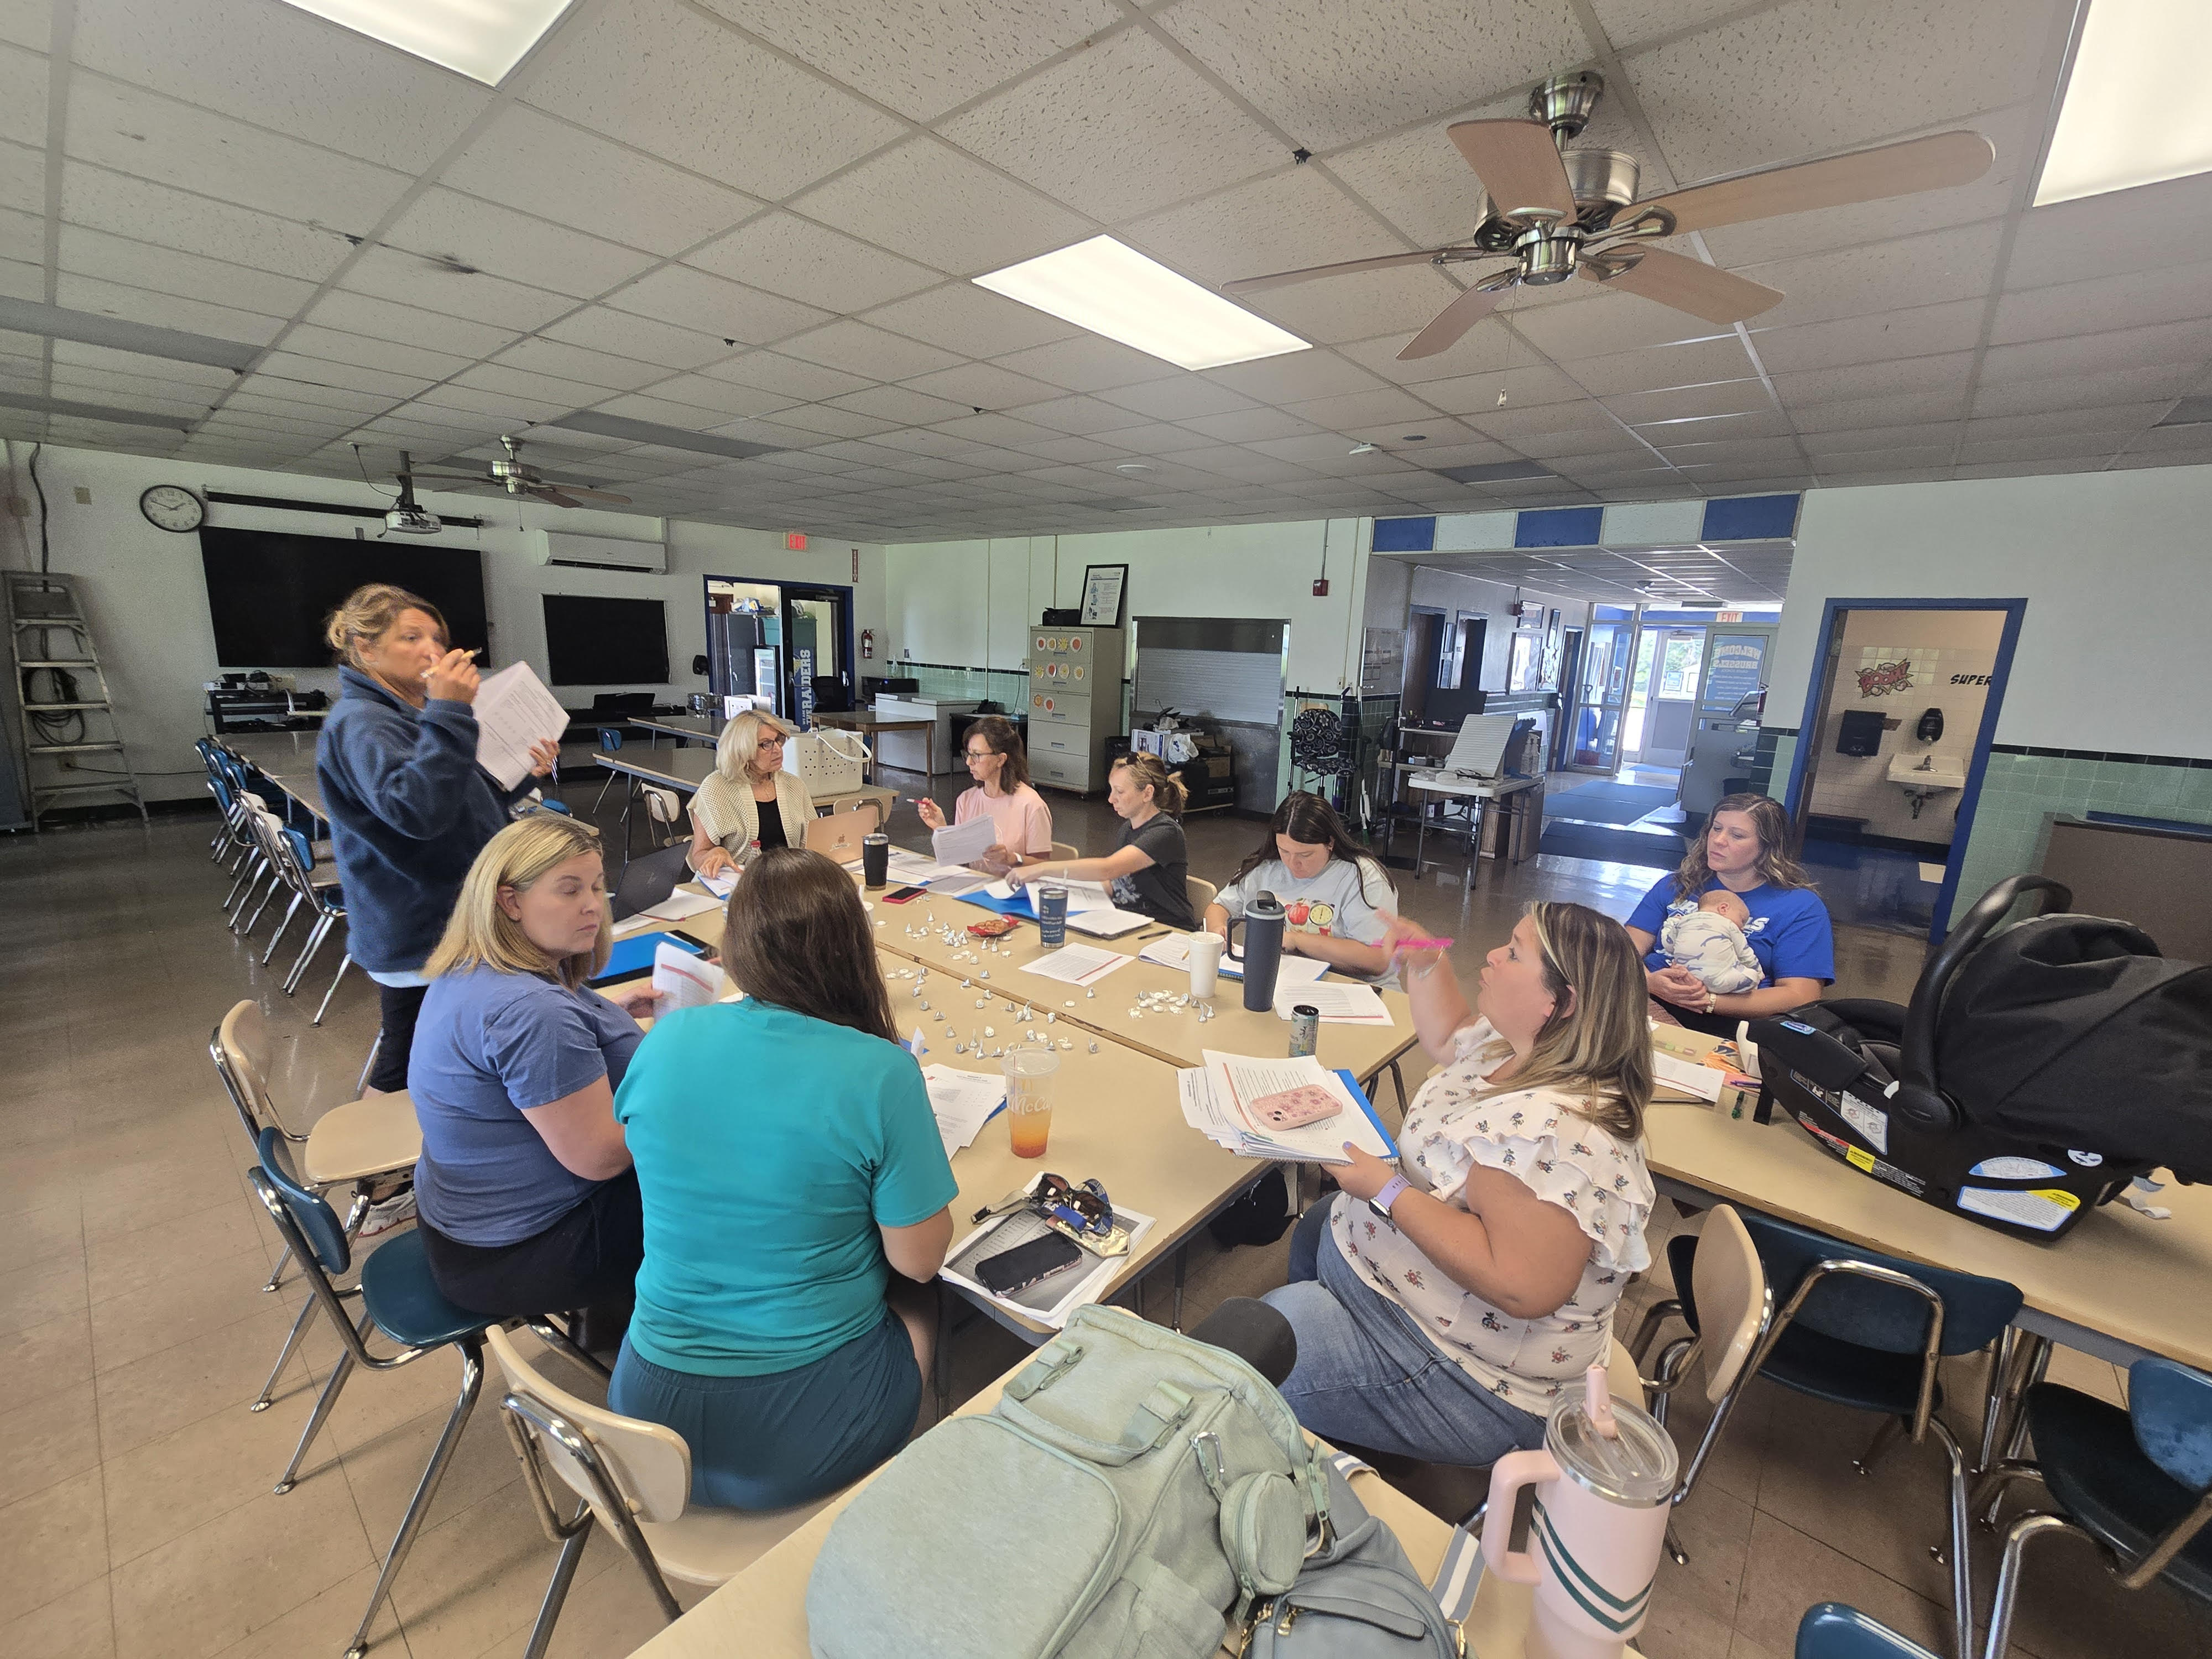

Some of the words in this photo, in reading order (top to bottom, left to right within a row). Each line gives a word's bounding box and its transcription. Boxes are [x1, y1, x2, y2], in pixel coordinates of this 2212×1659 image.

[789, 534, 806, 550] EXIT
[1721, 612, 1739, 622] EXIT
[800, 649, 812, 709] RAIDERS
[1859, 662, 1910, 692] BOOM!
[1950, 674, 1992, 686] SUPER
